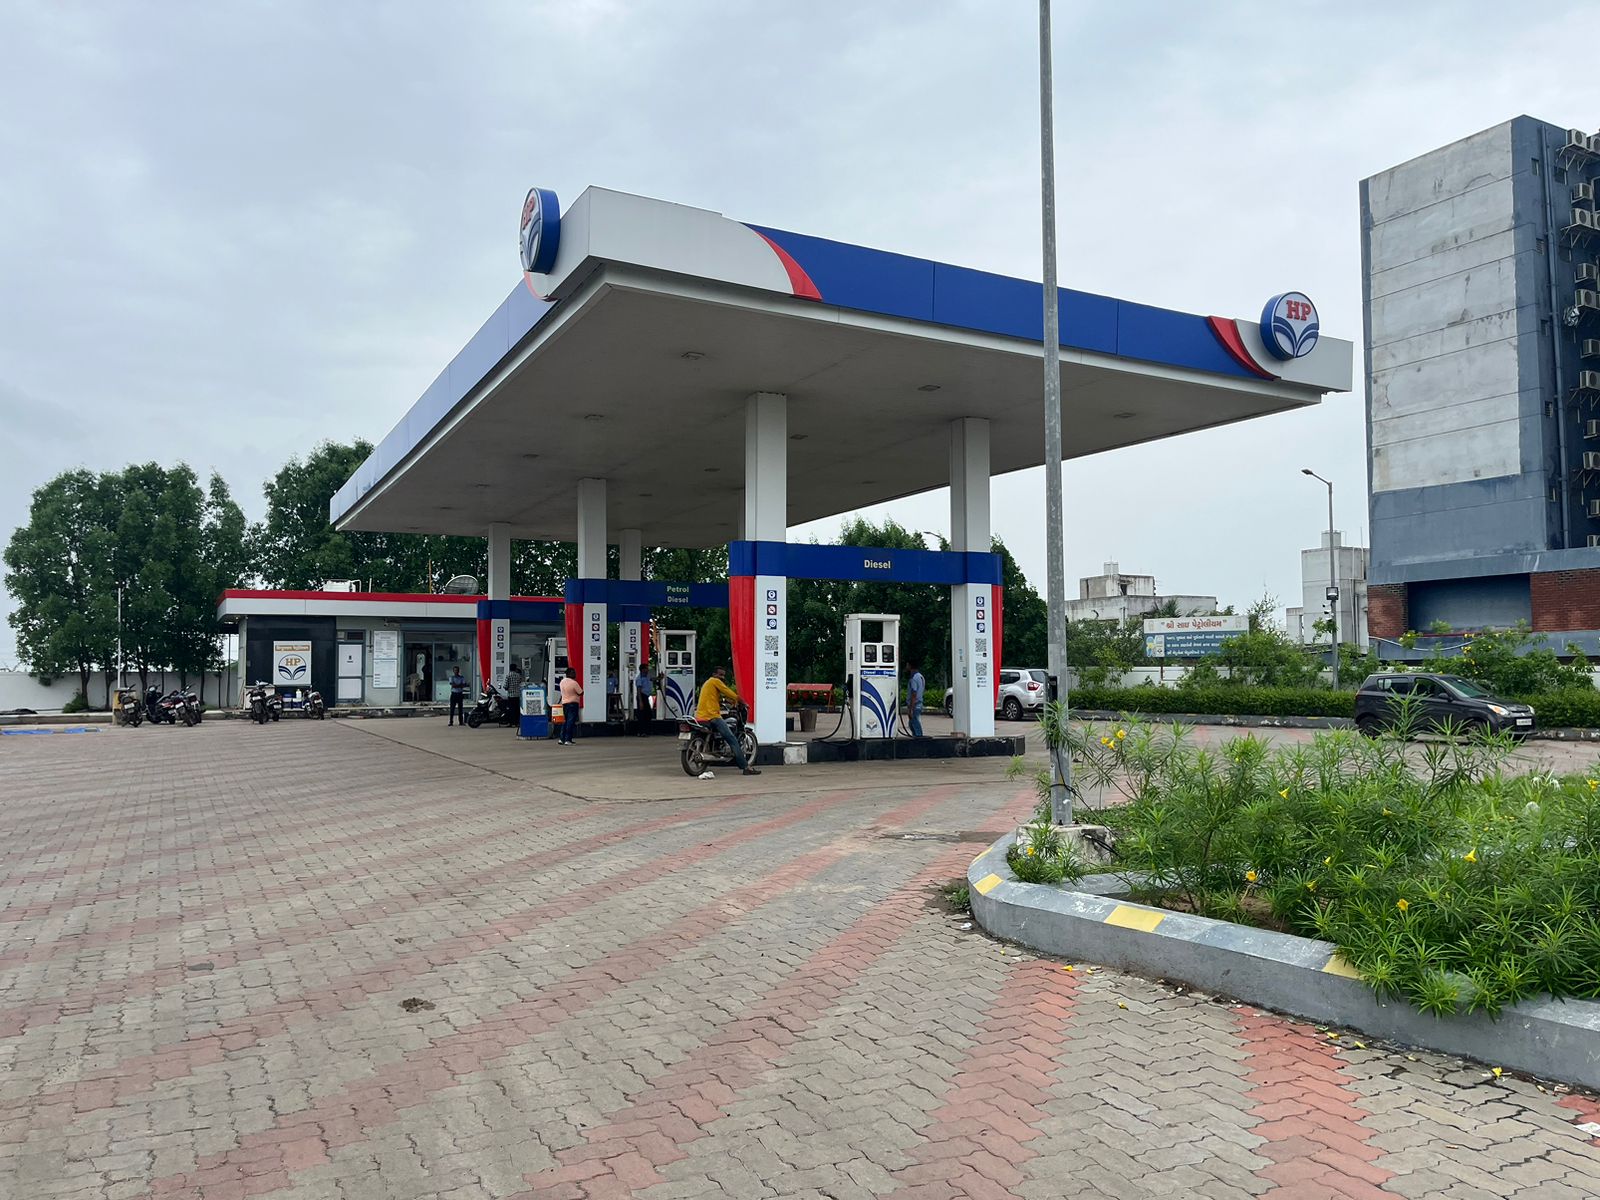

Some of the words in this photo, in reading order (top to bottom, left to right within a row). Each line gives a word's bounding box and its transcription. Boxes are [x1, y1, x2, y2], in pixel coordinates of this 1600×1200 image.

[1286, 300, 1312, 321] HP
[864, 559, 891, 569] Diesel
[666, 585, 690, 593] Petrol
[285, 658, 301, 666] HP
